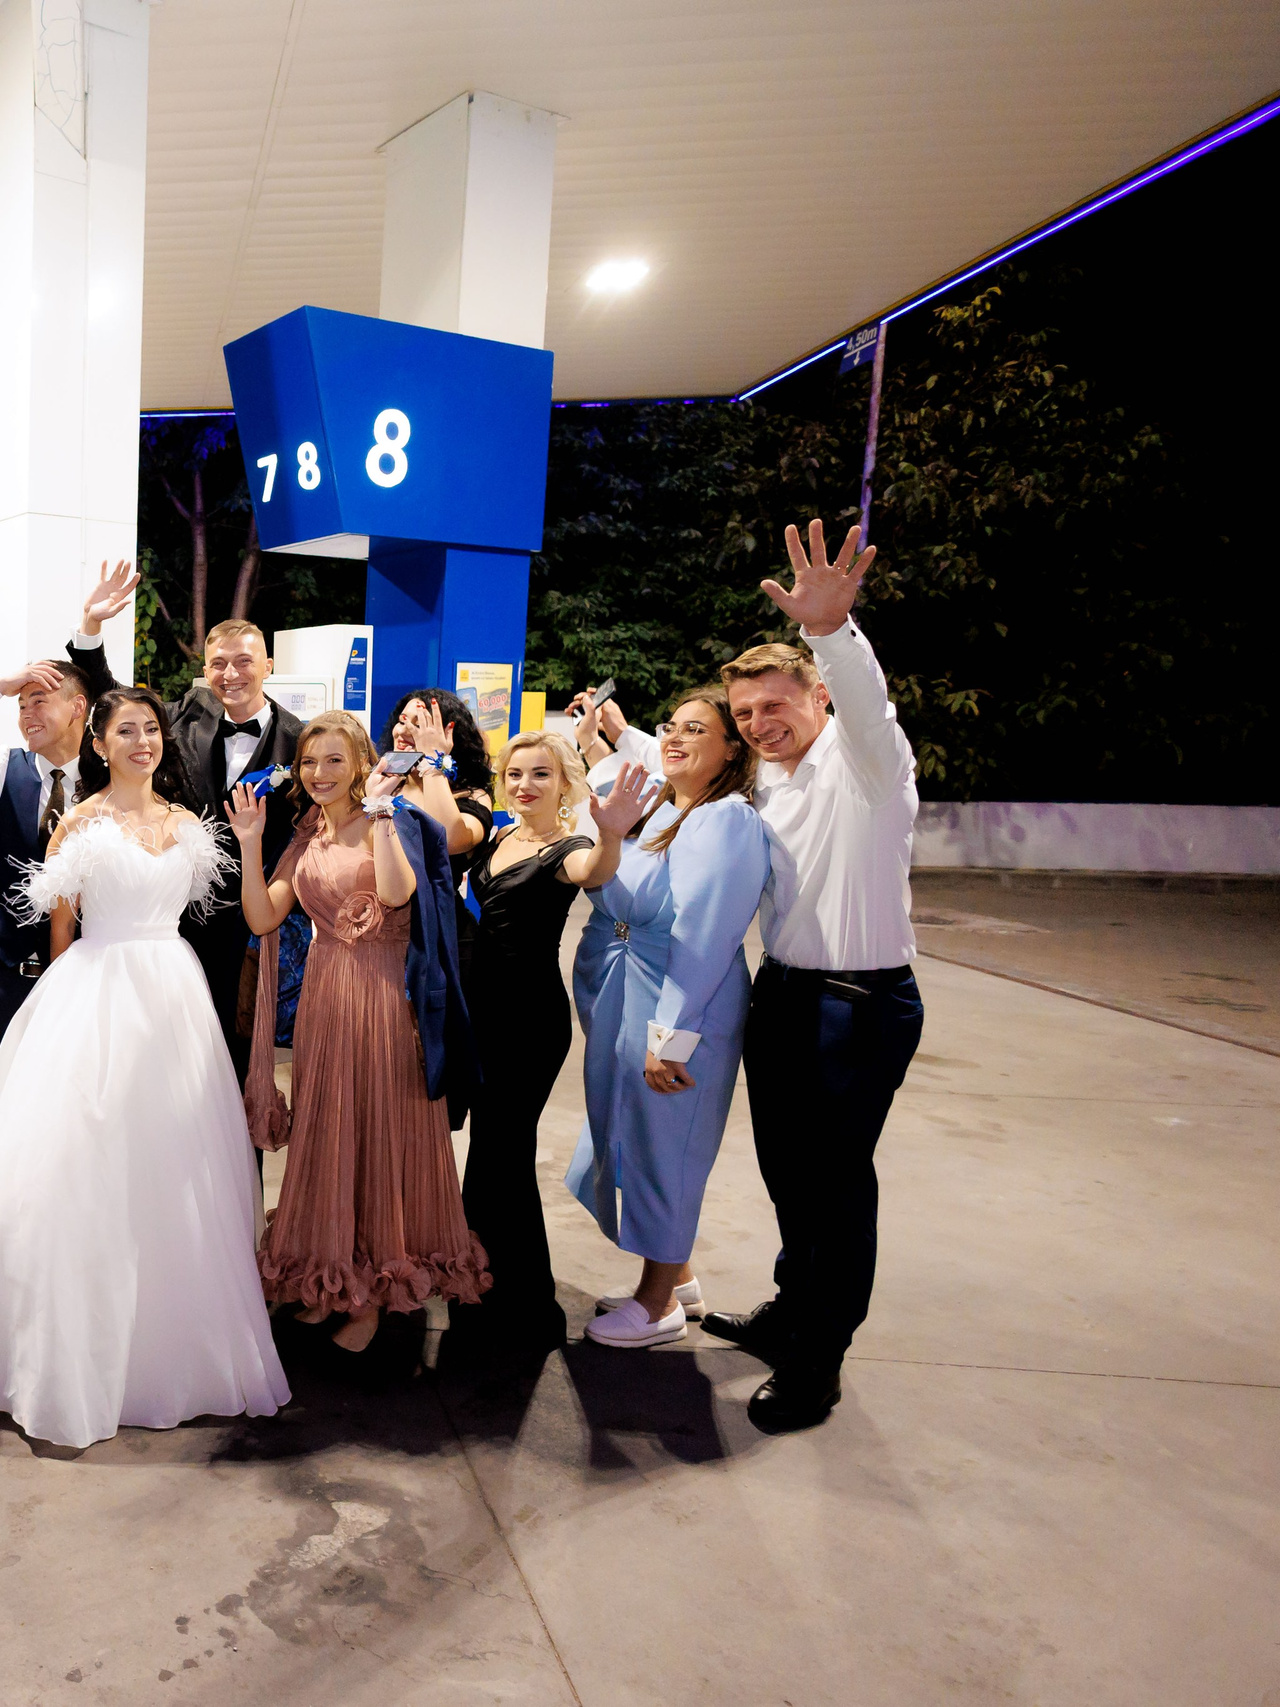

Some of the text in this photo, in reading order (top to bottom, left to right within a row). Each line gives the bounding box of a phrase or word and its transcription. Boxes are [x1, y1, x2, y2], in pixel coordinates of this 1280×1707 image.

[257, 441, 321, 502] 7 8
[365, 408, 411, 488] 8
